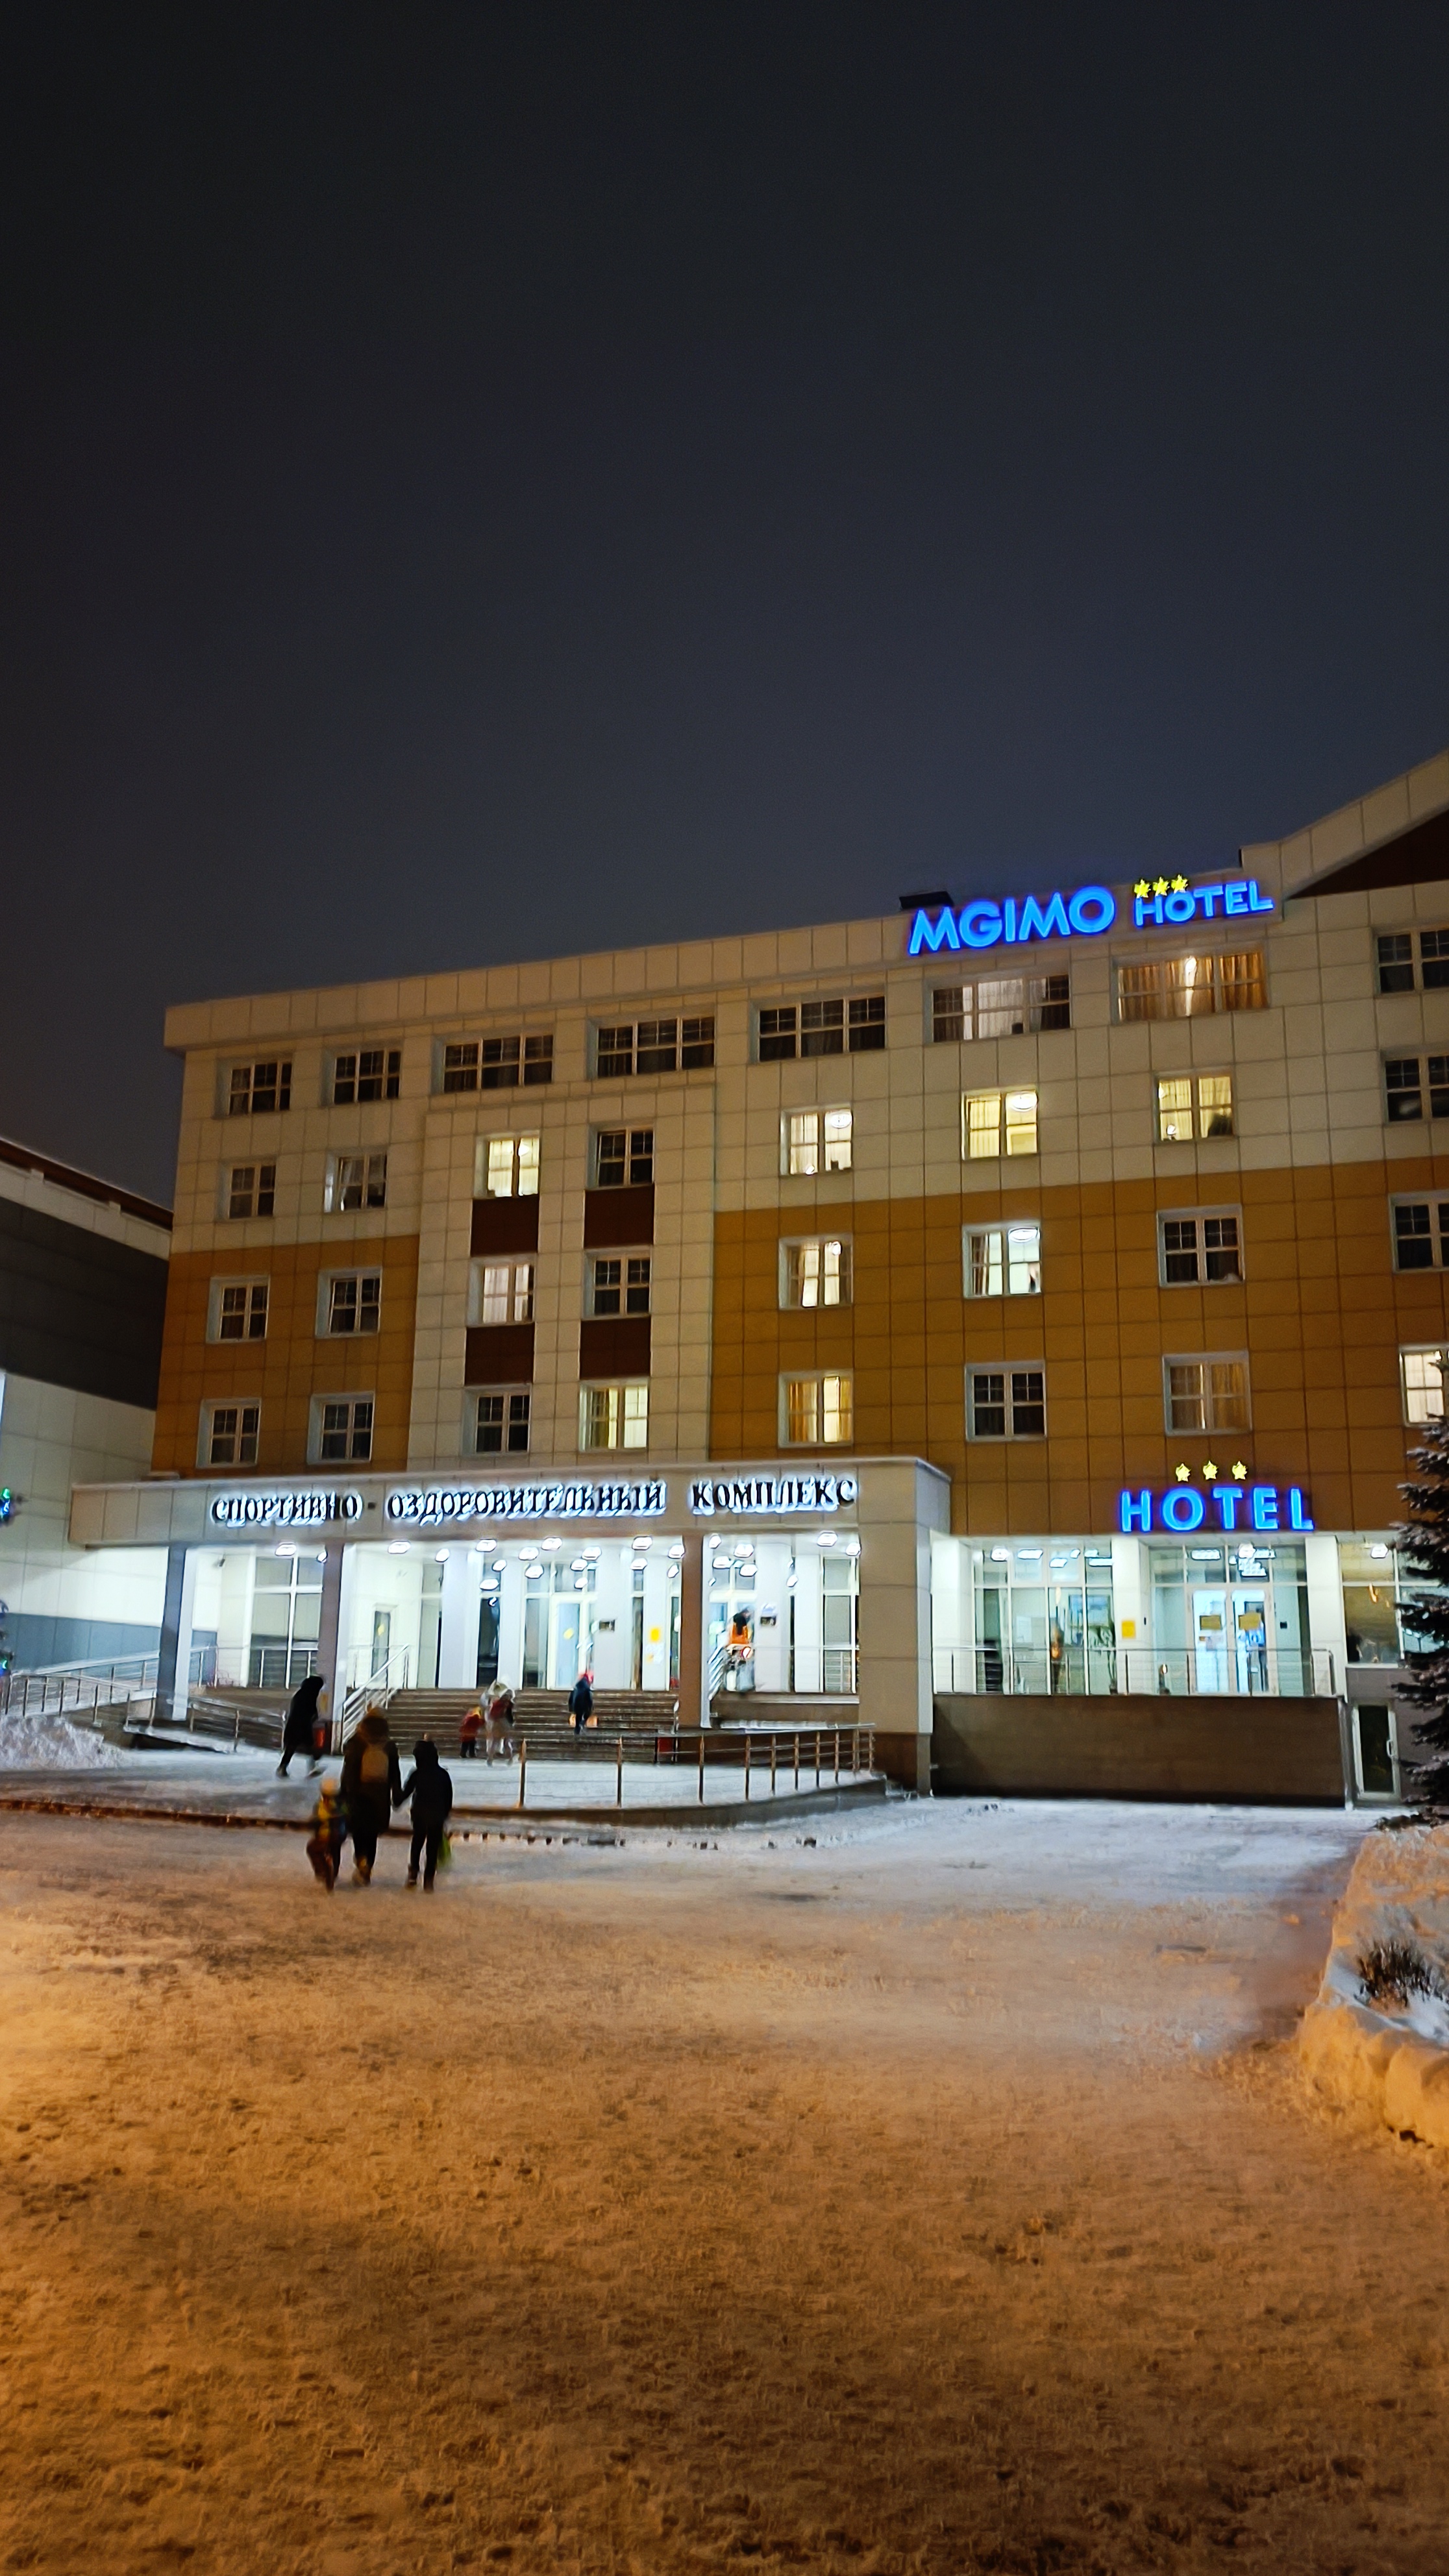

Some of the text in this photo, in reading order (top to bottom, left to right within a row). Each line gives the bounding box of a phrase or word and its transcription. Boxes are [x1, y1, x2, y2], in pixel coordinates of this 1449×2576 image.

[909, 880, 1274, 956] MGIMO HOTEL
[689, 1477, 857, 1515] КОМПЛЕКС
[1121, 1487, 1314, 1532] HOTEL
